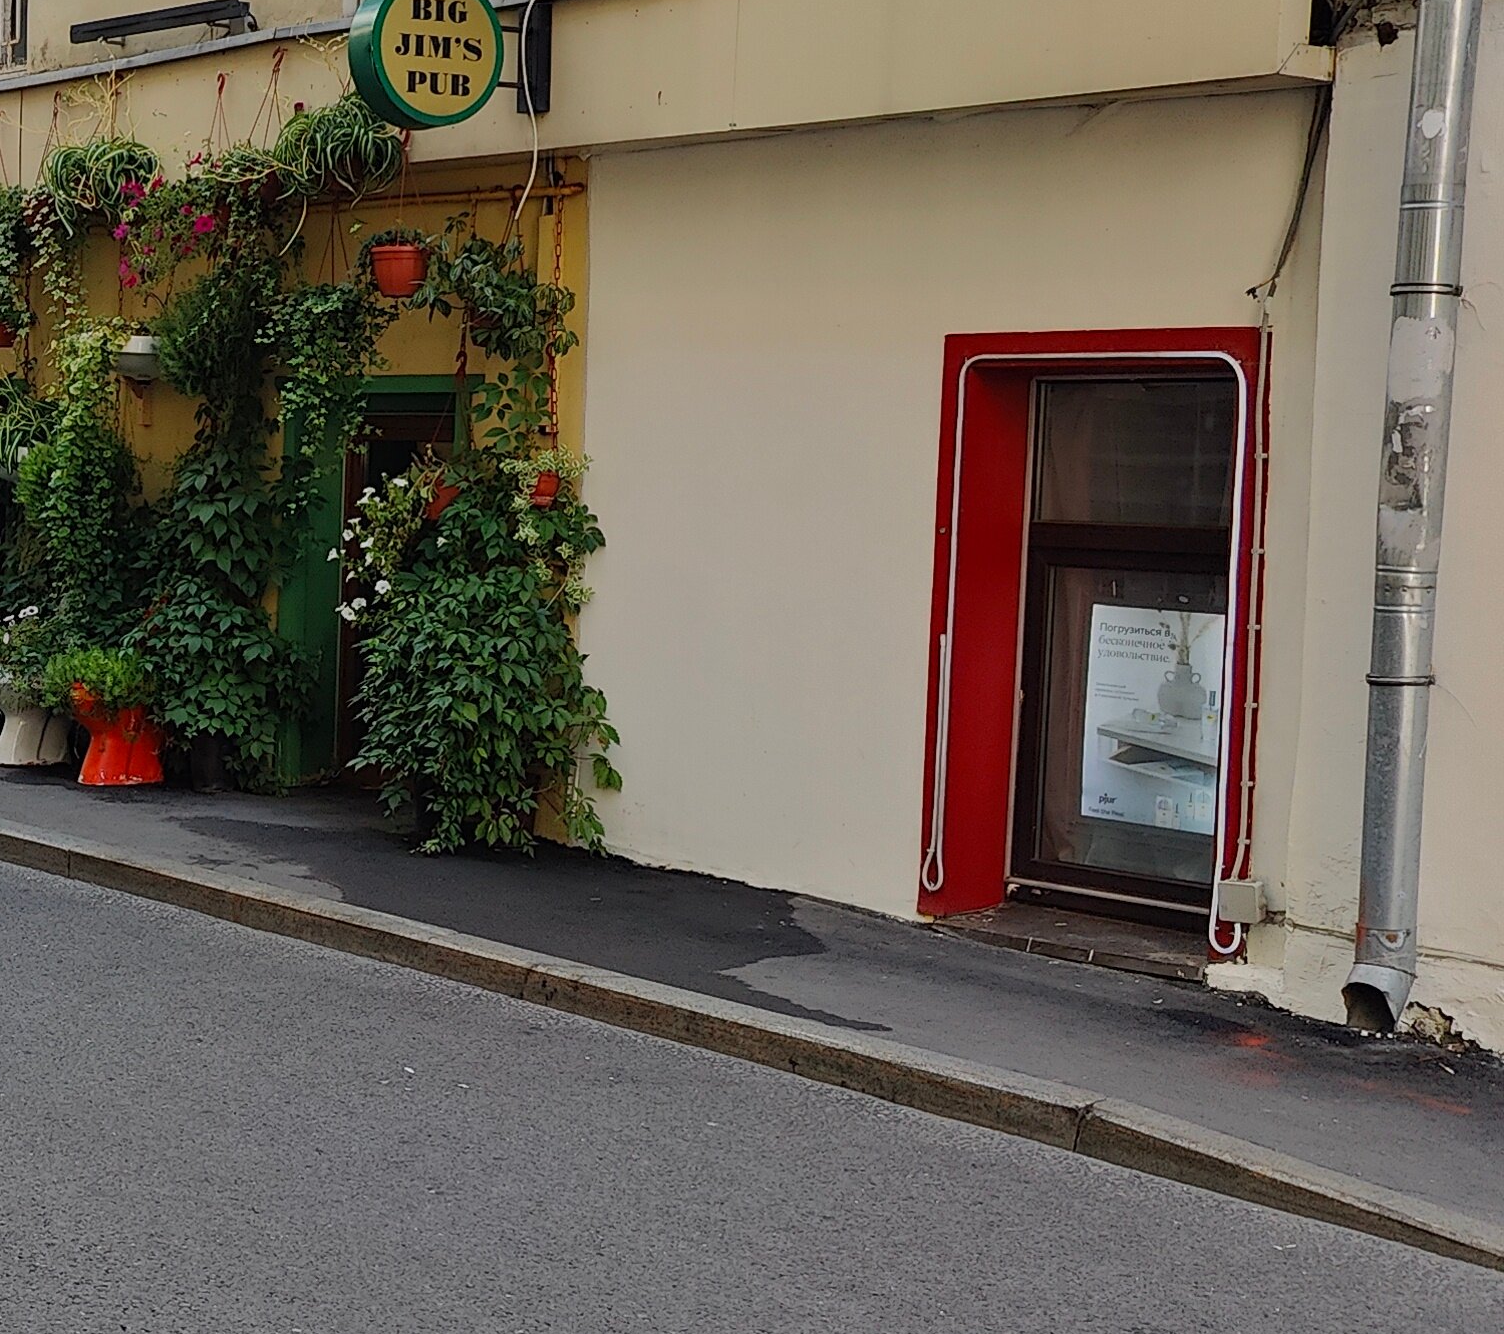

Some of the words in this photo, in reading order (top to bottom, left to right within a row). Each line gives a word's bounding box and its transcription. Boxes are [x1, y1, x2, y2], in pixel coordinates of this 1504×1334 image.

[395, 33, 483, 62] JIM'S
[406, 70, 471, 97] PUB
[1099, 622, 1162, 637] Погрузиться
[1098, 634, 1166, 651] бесконечное
[1098, 792, 1118, 805] pjur
